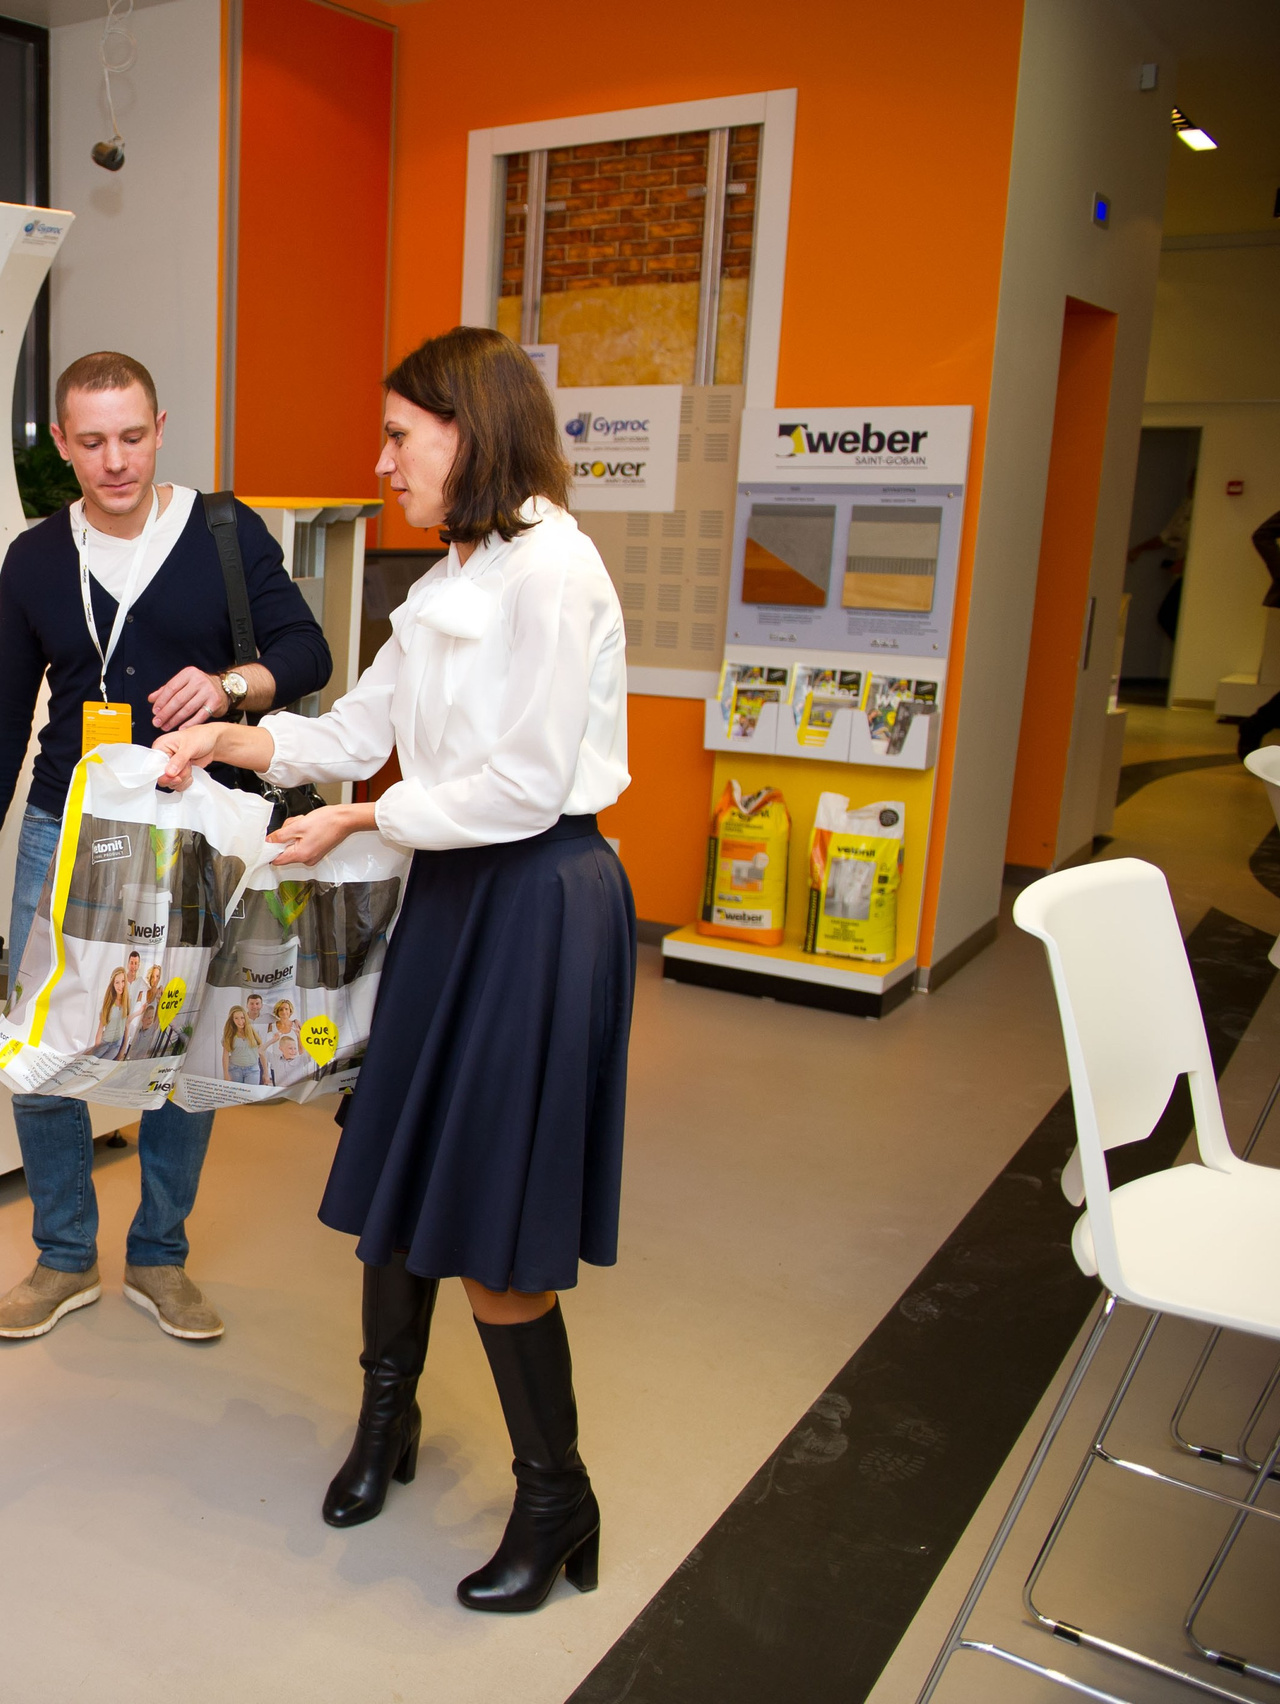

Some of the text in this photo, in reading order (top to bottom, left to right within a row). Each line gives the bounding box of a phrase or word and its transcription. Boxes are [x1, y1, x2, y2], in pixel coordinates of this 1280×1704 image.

[593, 416, 650, 436] Gyproc
[805, 422, 928, 454] weber
[855, 456, 927, 466] SAINT-GOBAIN
[250, 965, 293, 983] weber
[167, 989, 180, 999] we
[311, 1026, 329, 1035] we
